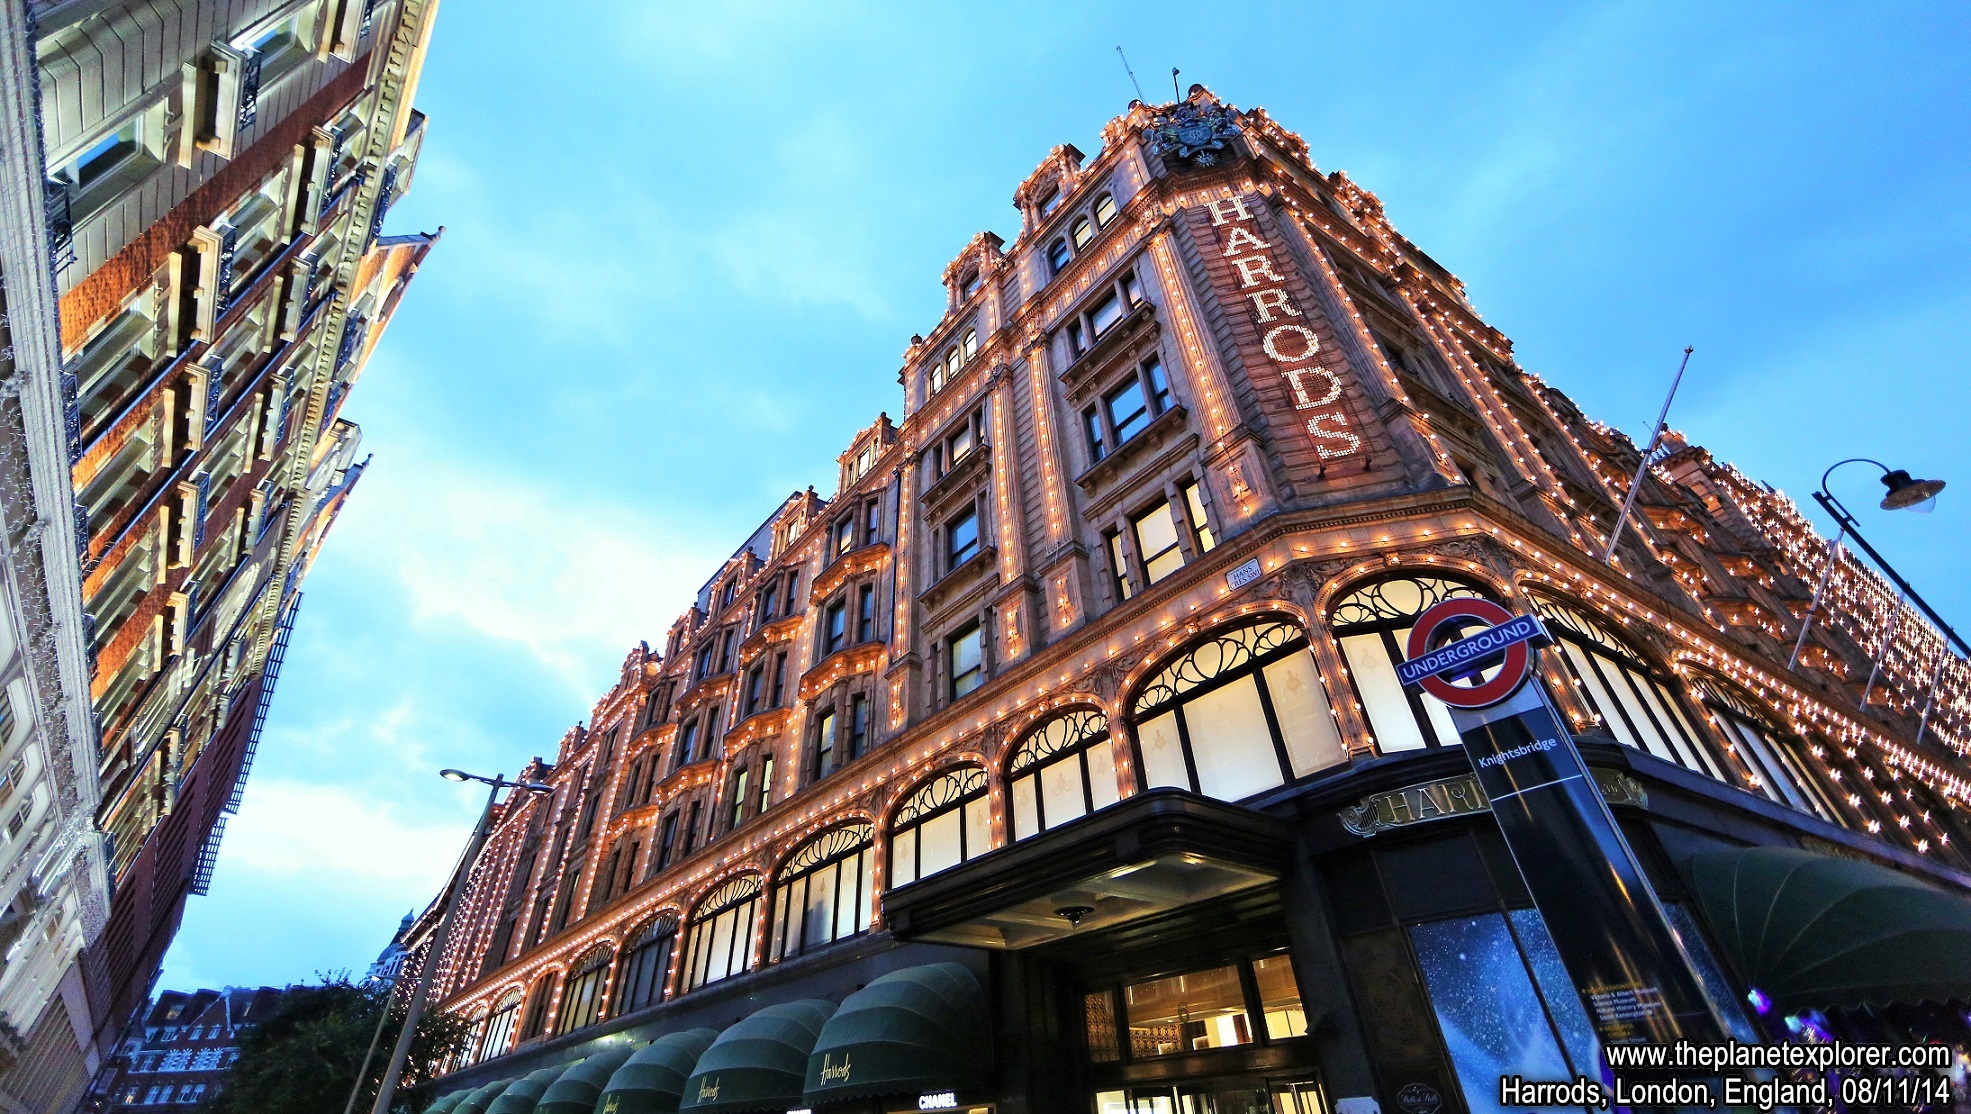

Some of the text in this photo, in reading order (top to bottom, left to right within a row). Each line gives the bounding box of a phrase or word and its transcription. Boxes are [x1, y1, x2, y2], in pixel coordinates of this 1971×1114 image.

[1203, 195, 1361, 460] HARRODS
[1232, 566, 1253, 580] HANS
[1402, 620, 1531, 680] UNDERGROUND
[1478, 737, 1558, 768] Knightsbridge
[820, 1053, 851, 1086] Harrods
[918, 1092, 958, 1110] CHANEL
